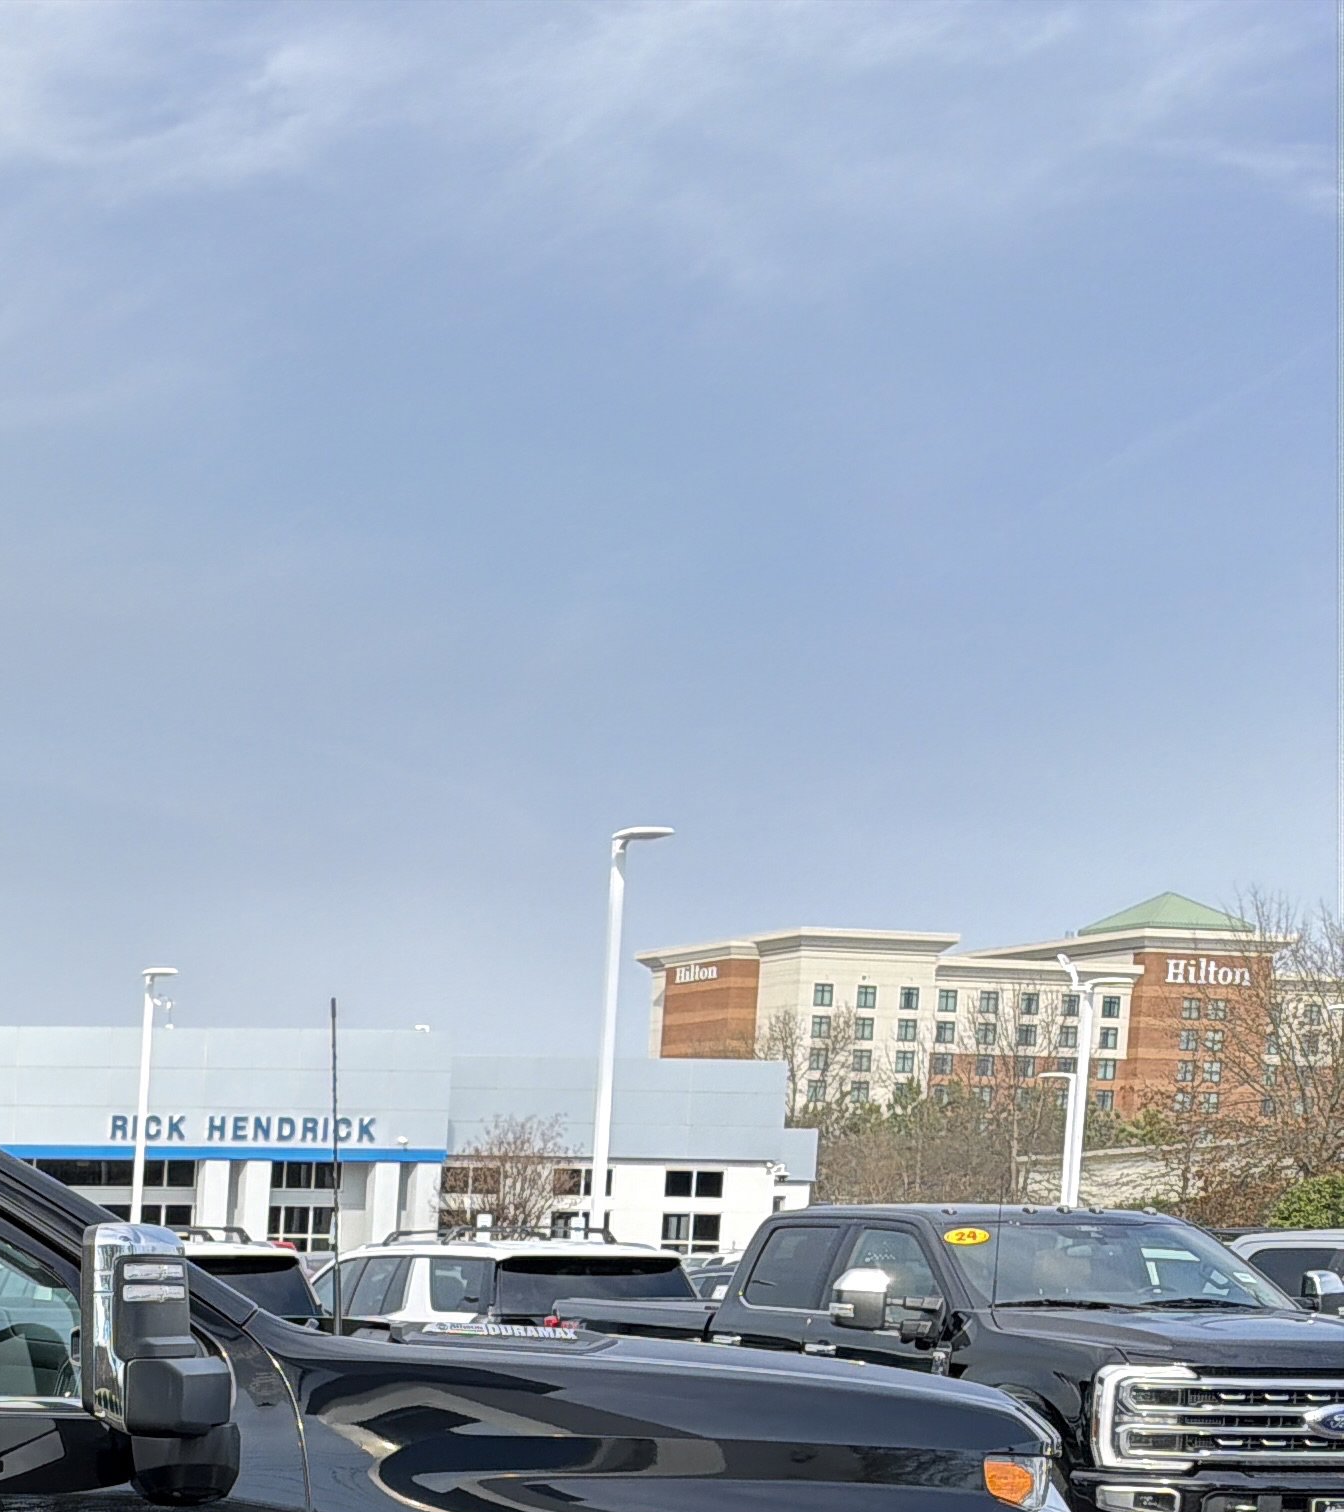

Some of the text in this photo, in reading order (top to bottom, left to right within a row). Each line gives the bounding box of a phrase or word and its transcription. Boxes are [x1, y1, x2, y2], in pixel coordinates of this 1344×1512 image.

[675, 964, 718, 984] Hilton
[1164, 957, 1252, 987] Hilton
[110, 1114, 377, 1143] RICK HENDRICK
[486, 1323, 579, 1340] DURAMAX
